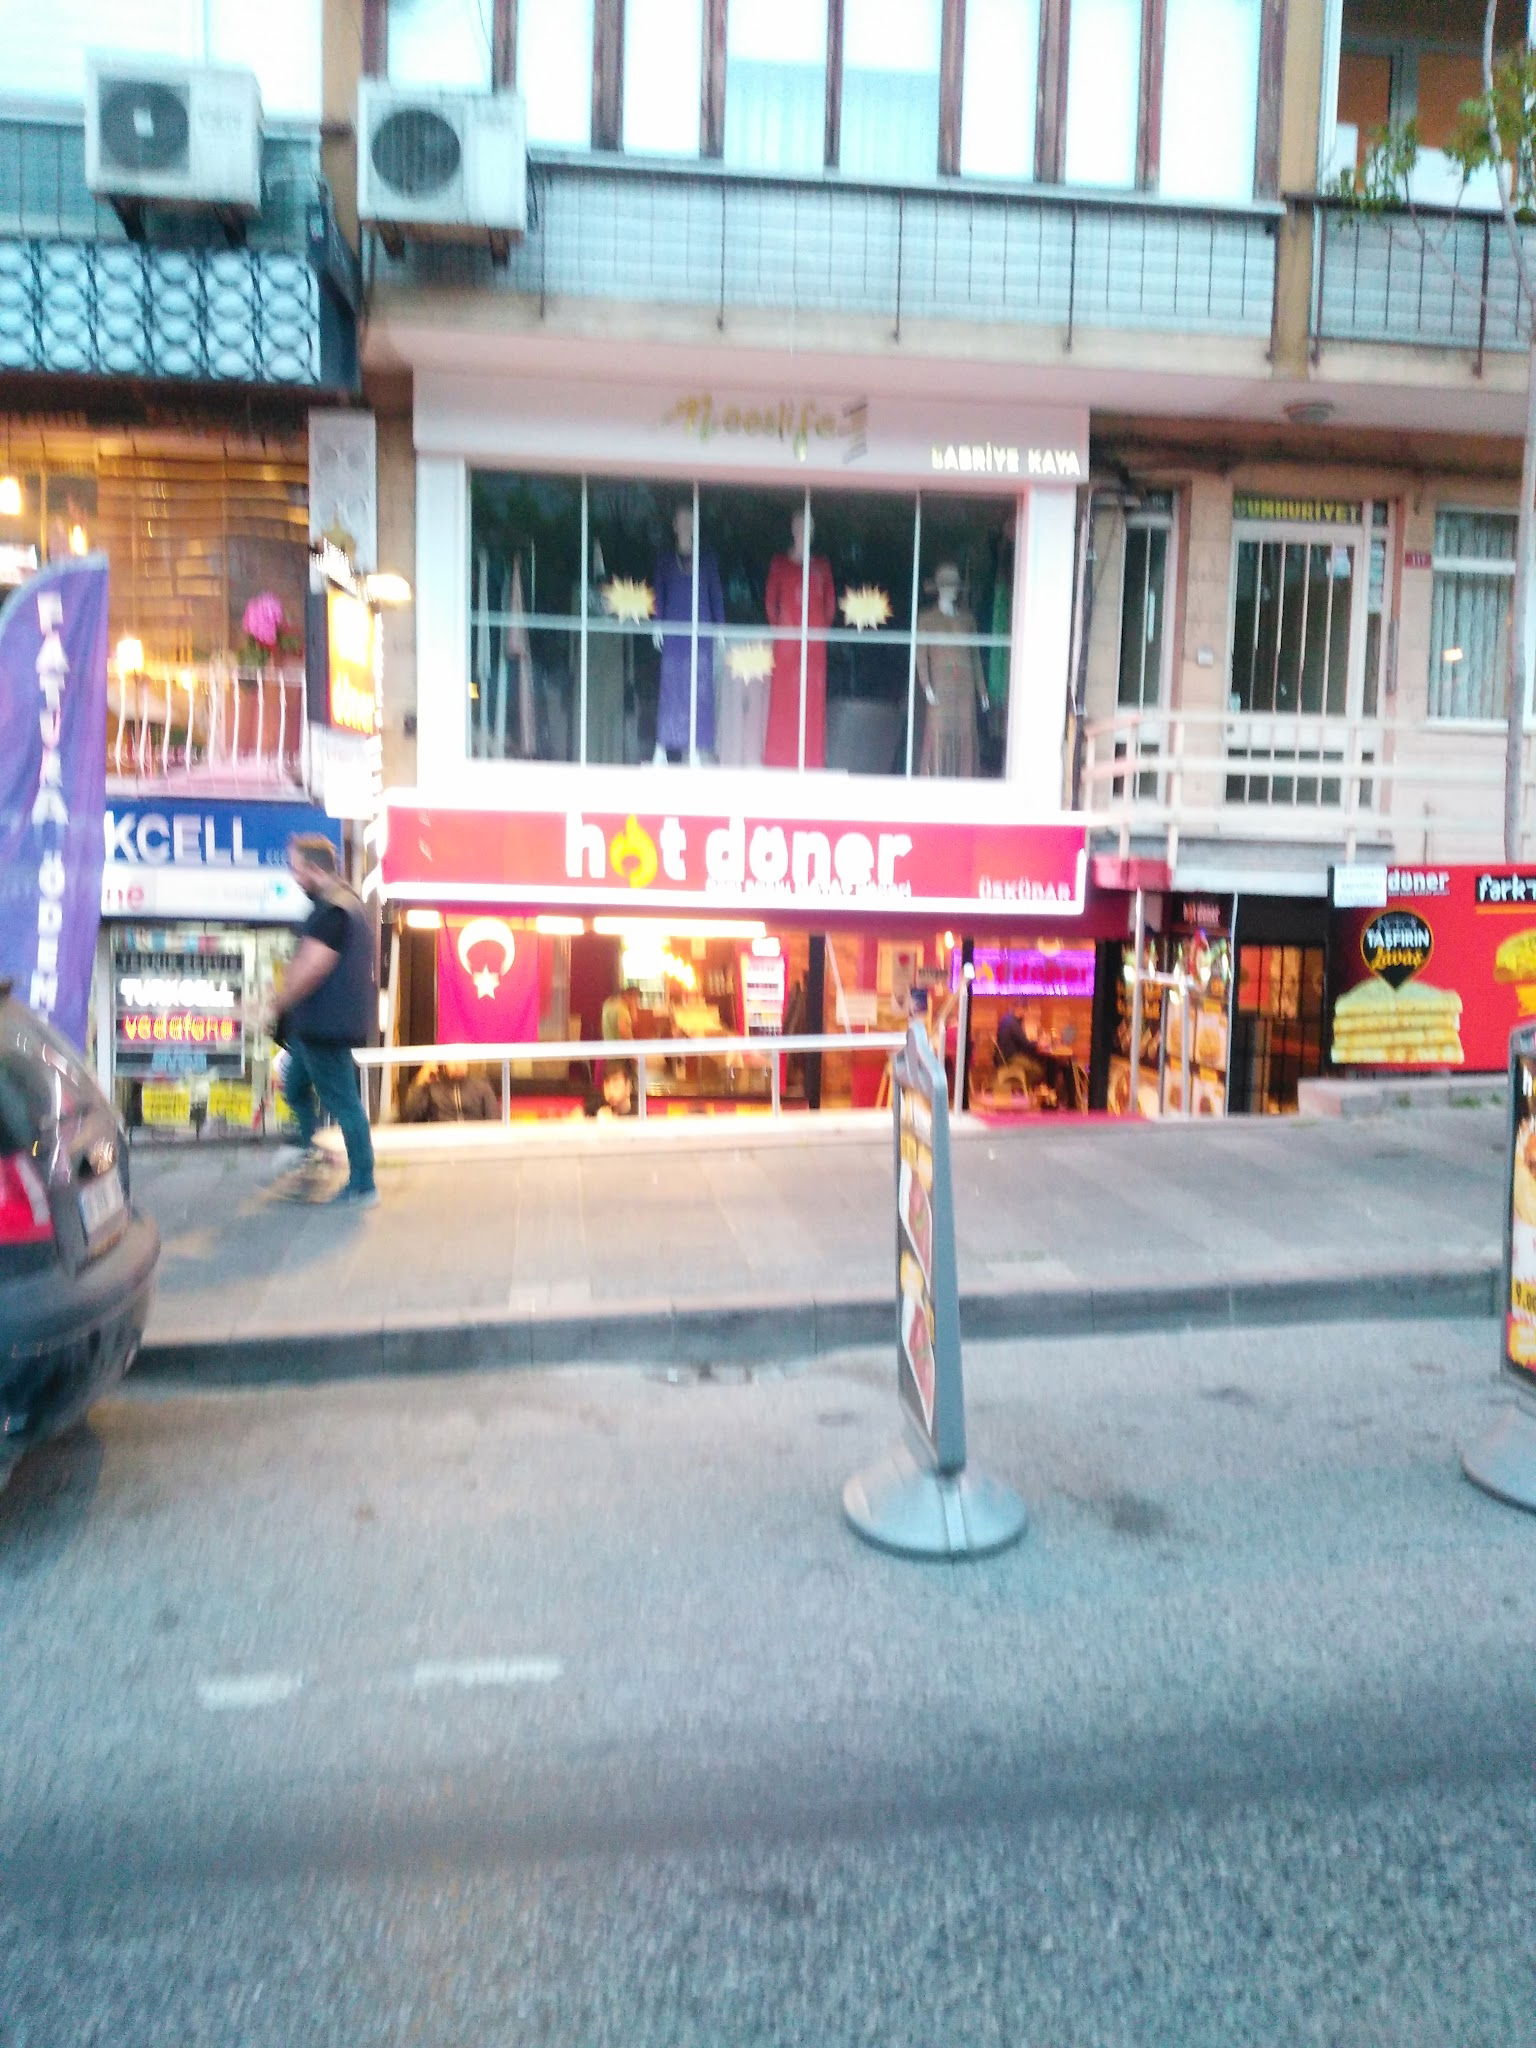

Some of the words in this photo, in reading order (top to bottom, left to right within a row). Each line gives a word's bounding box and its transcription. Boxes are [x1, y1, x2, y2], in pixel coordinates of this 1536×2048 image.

[1027, 447, 1081, 475] KAYA
[35, 591, 69, 825] FATURA
[104, 811, 259, 865] KCELL
[565, 811, 687, 888] hot
[705, 815, 913, 888] döner
[979, 875, 1071, 901] ÜSKÜDAR
[120, 978, 234, 1008] TURKCELL
[125, 1010, 235, 1041] vodafone
